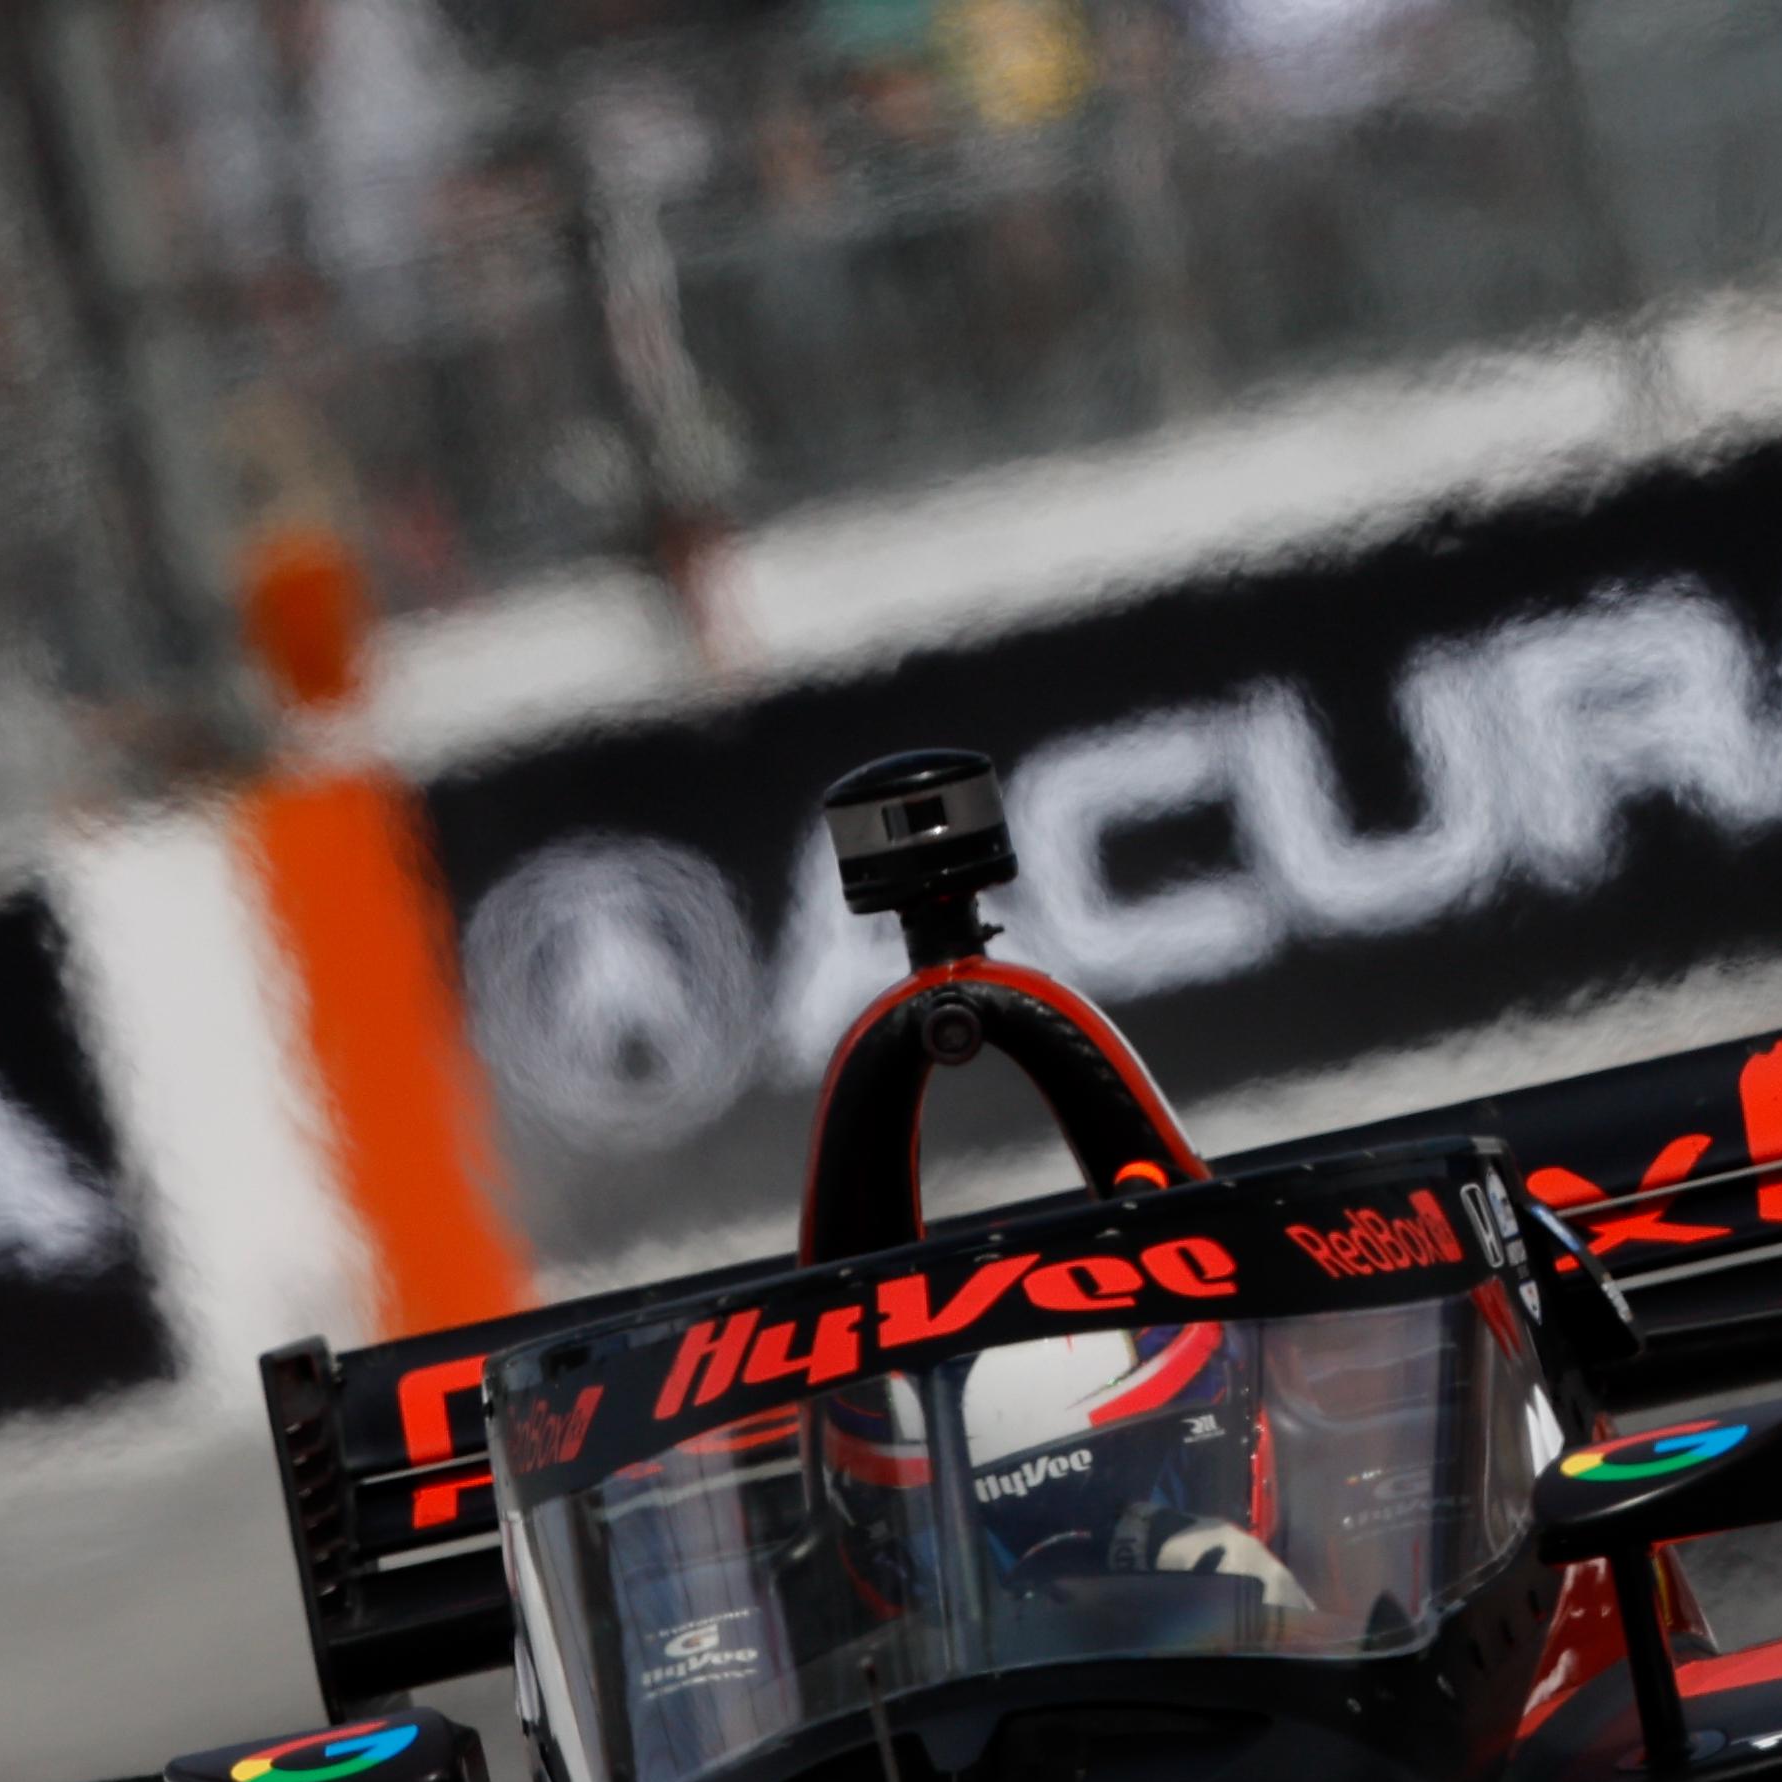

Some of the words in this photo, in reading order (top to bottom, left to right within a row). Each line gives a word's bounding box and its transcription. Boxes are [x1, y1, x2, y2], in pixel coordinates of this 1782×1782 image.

[1284, 1207, 1438, 1280] RedBox
[655, 1237, 1237, 1420] HyVee
[974, 1449, 1094, 1503] HyVee
